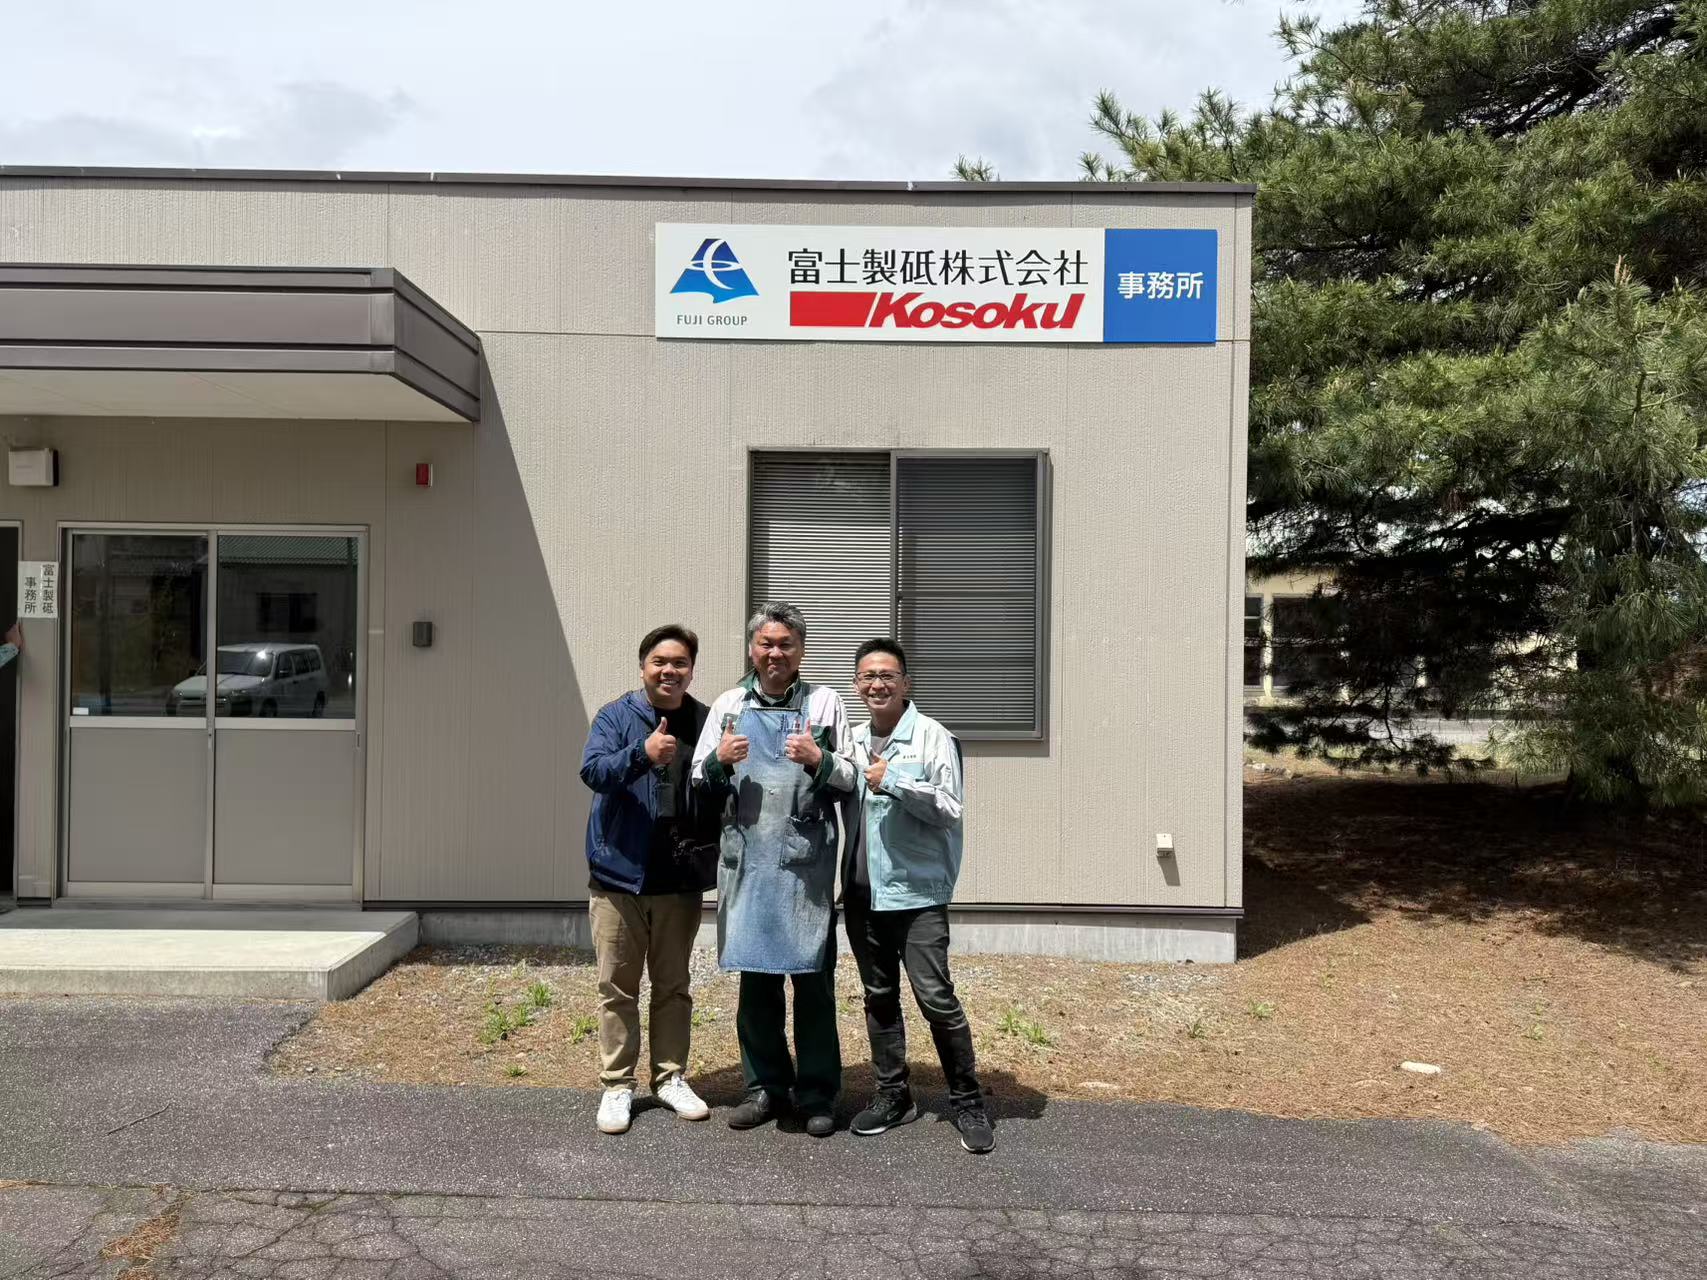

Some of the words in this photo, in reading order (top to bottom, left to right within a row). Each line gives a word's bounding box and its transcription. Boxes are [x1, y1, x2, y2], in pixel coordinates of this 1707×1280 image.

[788, 248, 1089, 286] 富士製砥株式会社
[1117, 271, 1204, 300] 事務所
[676, 314, 703, 325] FUJI
[707, 315, 748, 326] GROUP
[868, 291, 1086, 329] Kosoku
[24, 576, 37, 614] 事務所
[42, 563, 55, 614] 富士製砥
